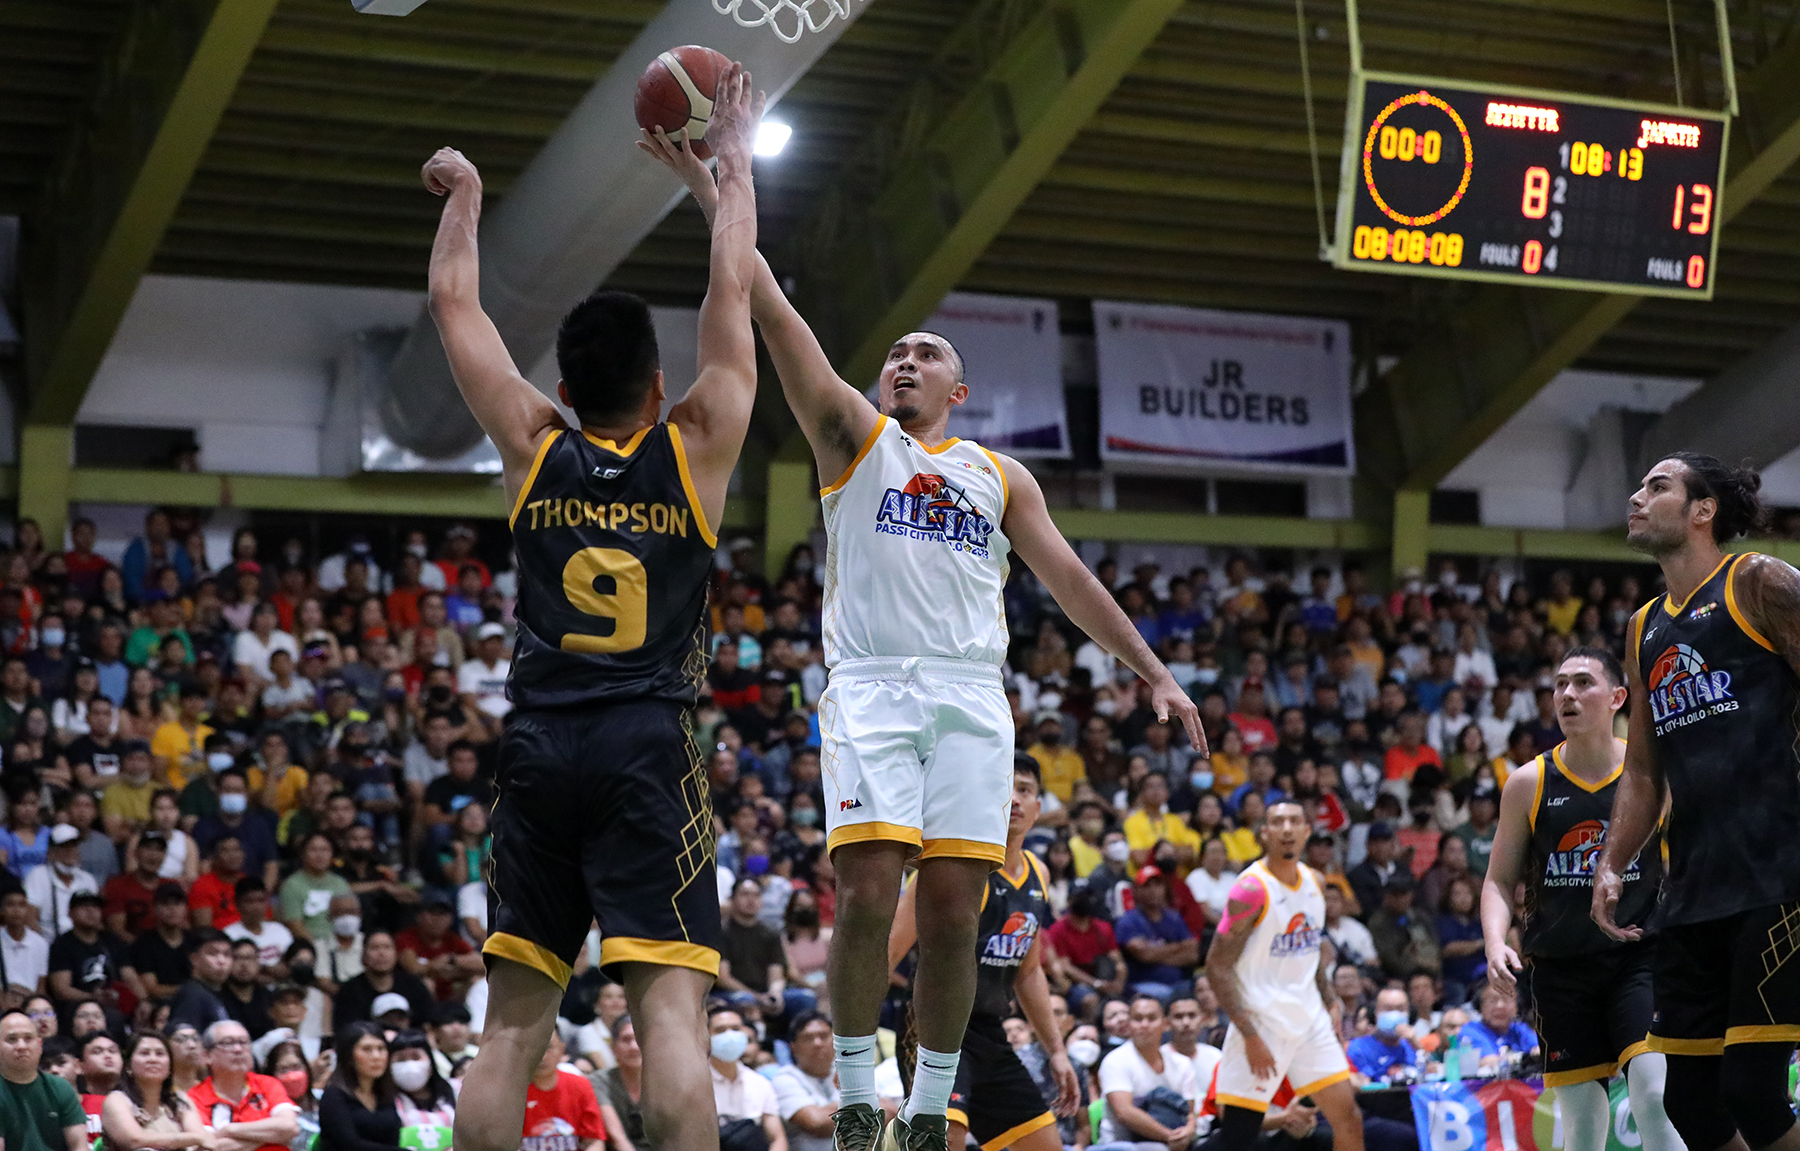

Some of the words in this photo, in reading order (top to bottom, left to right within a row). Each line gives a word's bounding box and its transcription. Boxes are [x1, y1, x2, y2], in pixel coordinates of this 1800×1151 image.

[1522, 166, 1550, 219] 8
[1553, 176, 1567, 203] 2
[1548, 212, 1563, 238] 3
[1673, 184, 1712, 235] 13
[1480, 241, 1520, 267] FOULS
[1522, 239, 1543, 274] 0
[1544, 244, 1559, 271] 4
[1647, 256, 1683, 281] FOULS
[1687, 255, 1704, 288] 0
[1204, 358, 1245, 391] JR
[1139, 385, 1310, 427] BUILDERS
[527, 498, 688, 538] THOMPSON
[876, 523, 907, 536] PASSI
[560, 546, 648, 654] 9
[1711, 701, 1739, 716] 2023
